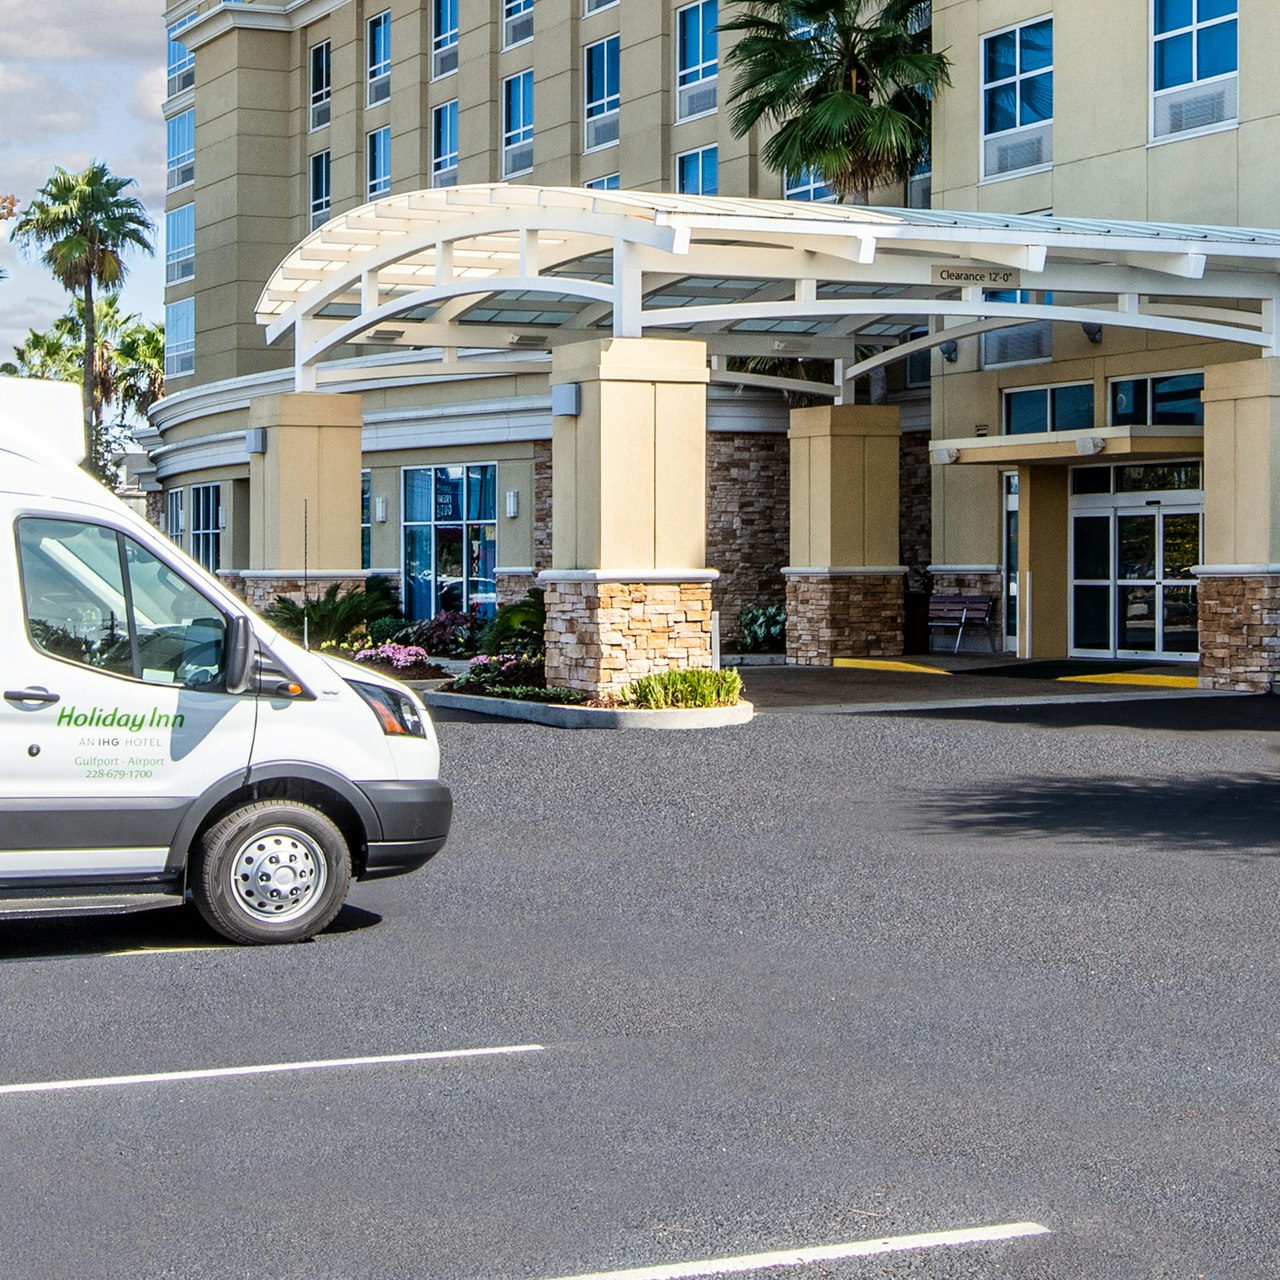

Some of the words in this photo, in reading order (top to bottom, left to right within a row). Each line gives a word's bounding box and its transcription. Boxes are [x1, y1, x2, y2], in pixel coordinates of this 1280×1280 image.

[939, 269, 986, 282] Clearance
[56, 705, 146, 733] Holiday
[149, 706, 186, 729] Inn
[78, 738, 95, 747] AN
[98, 738, 120, 747] IHG
[125, 738, 163, 747] HOTEL
[74, 756, 119, 768] Gulfport
[127, 757, 165, 768] Airport
[85, 769, 153, 780] 228-679-1700
